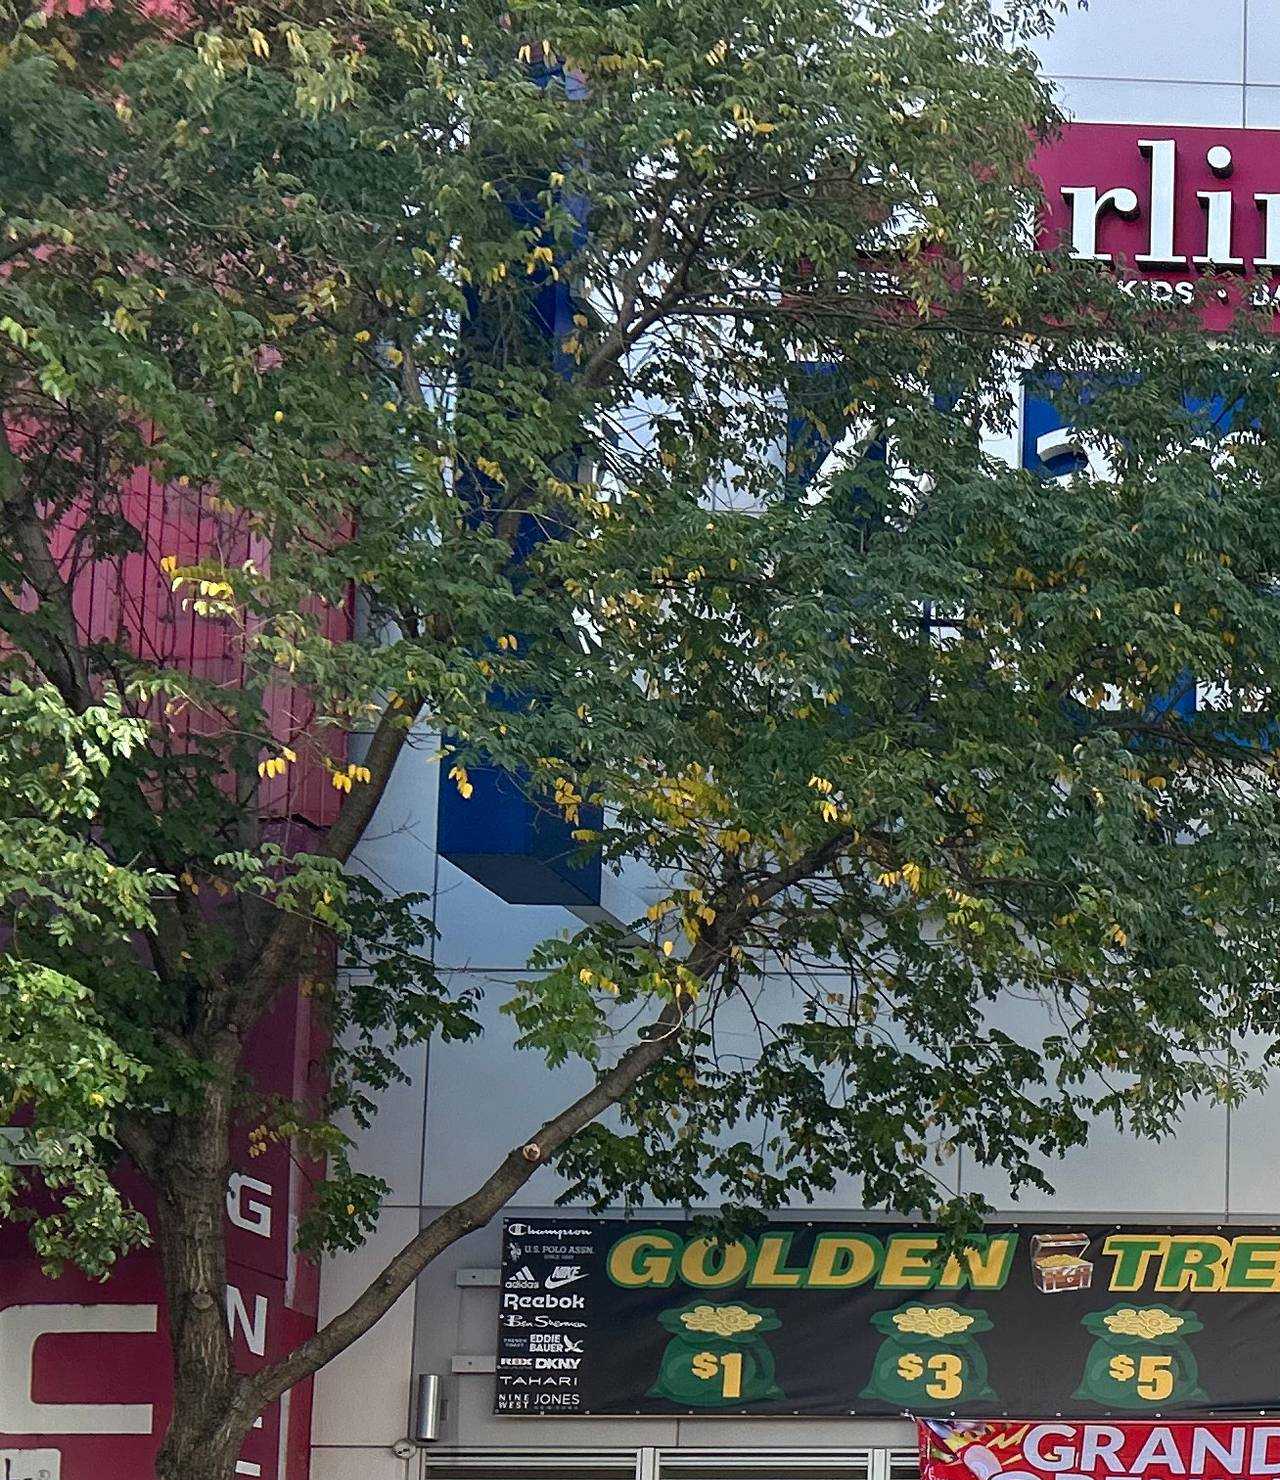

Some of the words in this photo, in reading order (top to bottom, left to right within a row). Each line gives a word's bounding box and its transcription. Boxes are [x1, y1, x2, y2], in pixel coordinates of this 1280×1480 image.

[508, 1223, 592, 1240] Champion
[542, 1244, 567, 1254] POLO
[609, 1230, 1018, 1289] GOLDEN
[551, 1265, 581, 1279] NIKE
[504, 1280, 540, 1290] adidas
[503, 1292, 585, 1311] Reebok
[529, 1333, 561, 1344] EDDIE
[529, 1343, 564, 1353] BAUER
[534, 1357, 582, 1370] DKNY
[499, 1376, 577, 1387] TAHARI
[692, 1352, 743, 1398] $1
[898, 1353, 963, 1399] $3
[1109, 1354, 1174, 1401] $5
[498, 1393, 530, 1401] NINE
[533, 1393, 581, 1406] JONES
[498, 1401, 529, 1410] WEST
